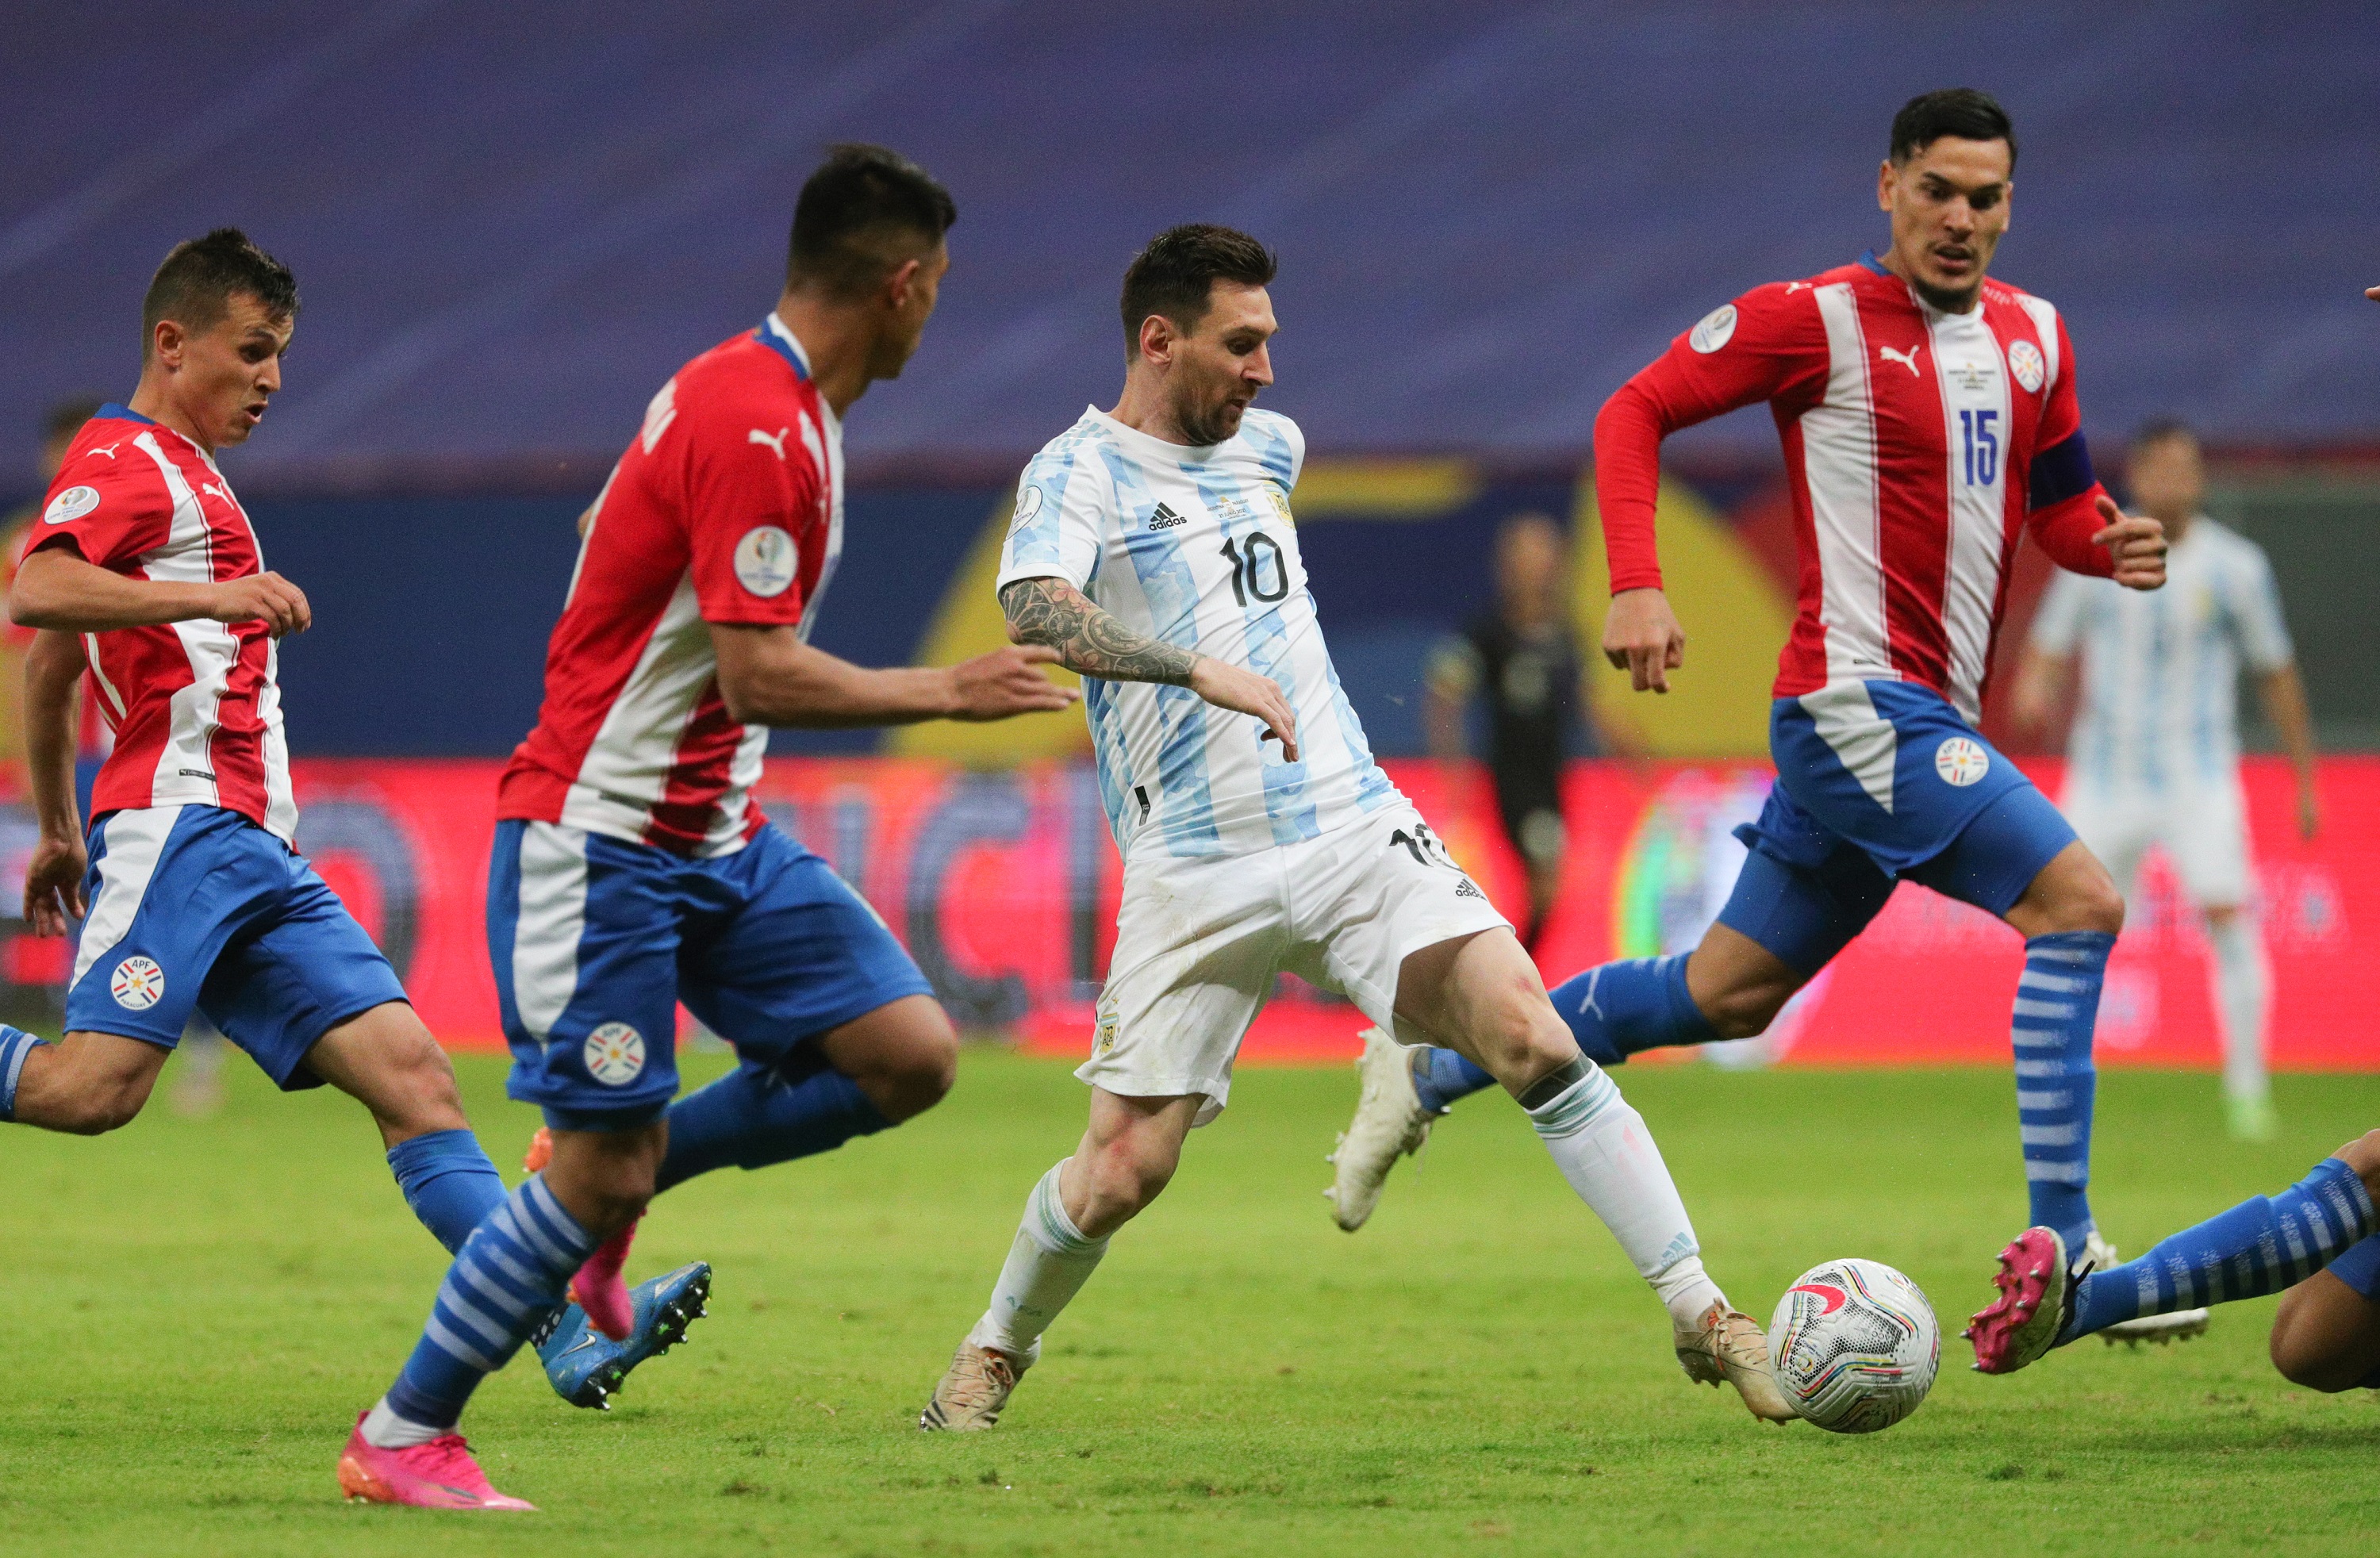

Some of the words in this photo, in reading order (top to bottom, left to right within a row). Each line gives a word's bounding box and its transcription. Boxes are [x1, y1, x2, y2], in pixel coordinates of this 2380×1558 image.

[1960, 410, 1998, 485] 15
[1148, 516, 1187, 531] adidas
[1219, 531, 1289, 608] 10
[1388, 823, 1467, 874] 10
[132, 959, 151, 969] APF
[120, 998, 147, 1008] PARAGUAY
